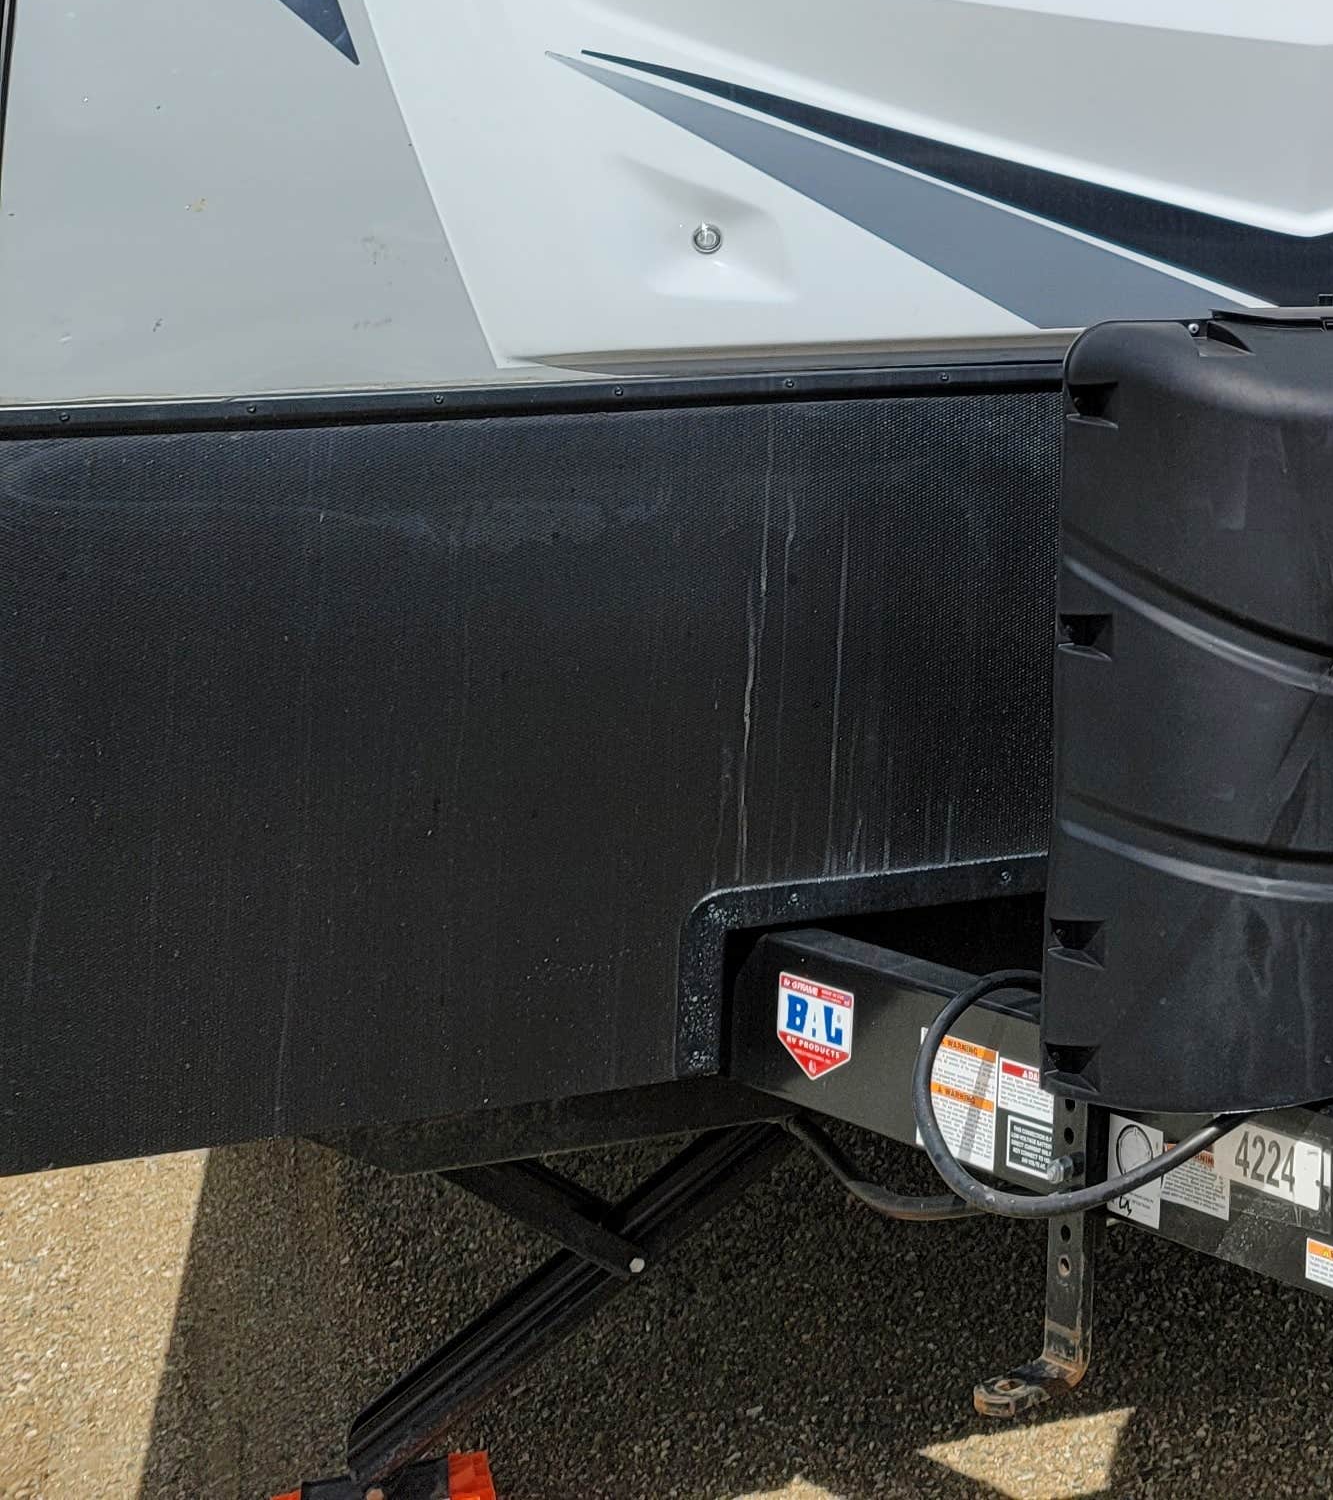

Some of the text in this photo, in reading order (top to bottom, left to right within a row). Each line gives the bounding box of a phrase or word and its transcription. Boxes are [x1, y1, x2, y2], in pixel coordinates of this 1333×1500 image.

[799, 1038, 841, 1060] PRODUCTS
[947, 1038, 979, 1057] WARNING
[1234, 1131, 1296, 1193] 4224
